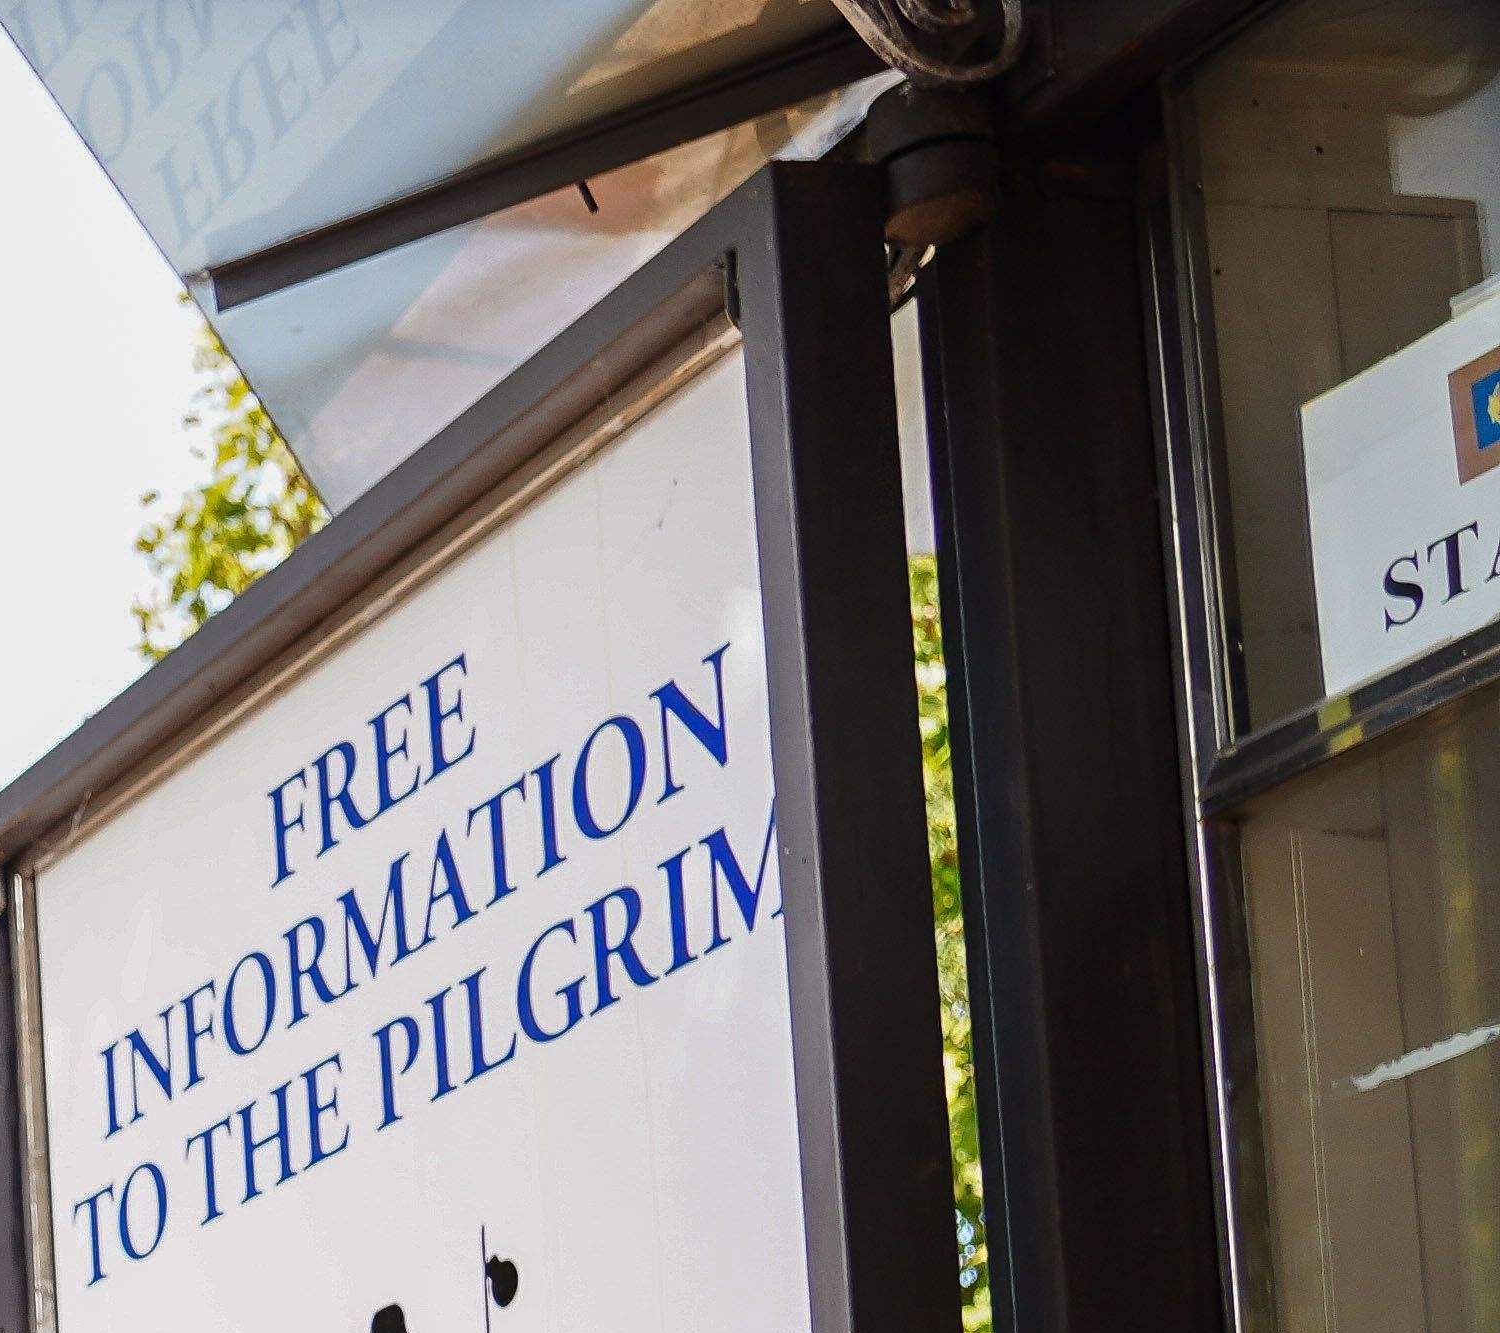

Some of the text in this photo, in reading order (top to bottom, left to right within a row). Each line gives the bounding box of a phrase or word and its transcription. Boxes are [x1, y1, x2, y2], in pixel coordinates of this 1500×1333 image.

[1383, 520, 1500, 633] ST
[100, 642, 731, 1140] INFORMATION
[266, 652, 477, 889] FREE
[73, 797, 784, 1288] TO THE PILGRIM
